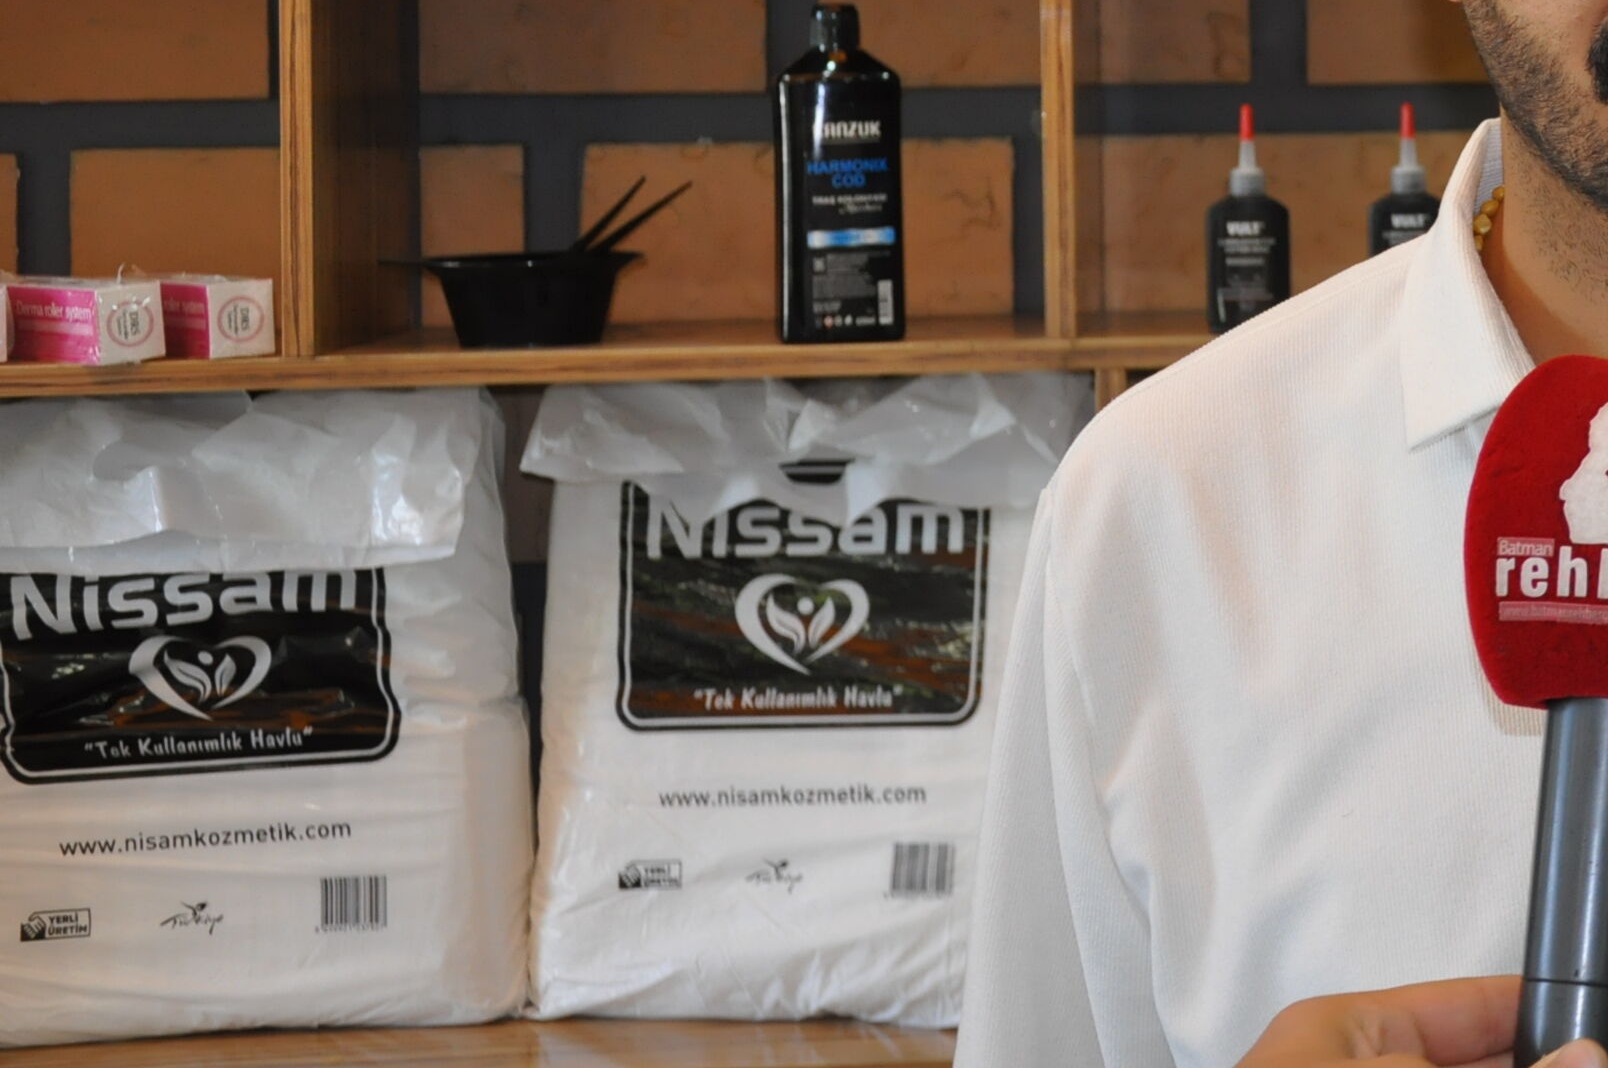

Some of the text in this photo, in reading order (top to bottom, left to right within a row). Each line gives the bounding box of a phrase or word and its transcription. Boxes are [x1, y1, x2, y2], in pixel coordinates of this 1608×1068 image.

[647, 494, 964, 560] Nissam
[1499, 539, 1552, 557] Batman
[10, 571, 357, 641] Nissam
[658, 783, 927, 808] www.nisamkozmetik.com
[59, 821, 352, 856] www.nisamkozmetik.com
[47, 923, 88, 936] ÜRETİM
[48, 912, 79, 924] YERLİ
